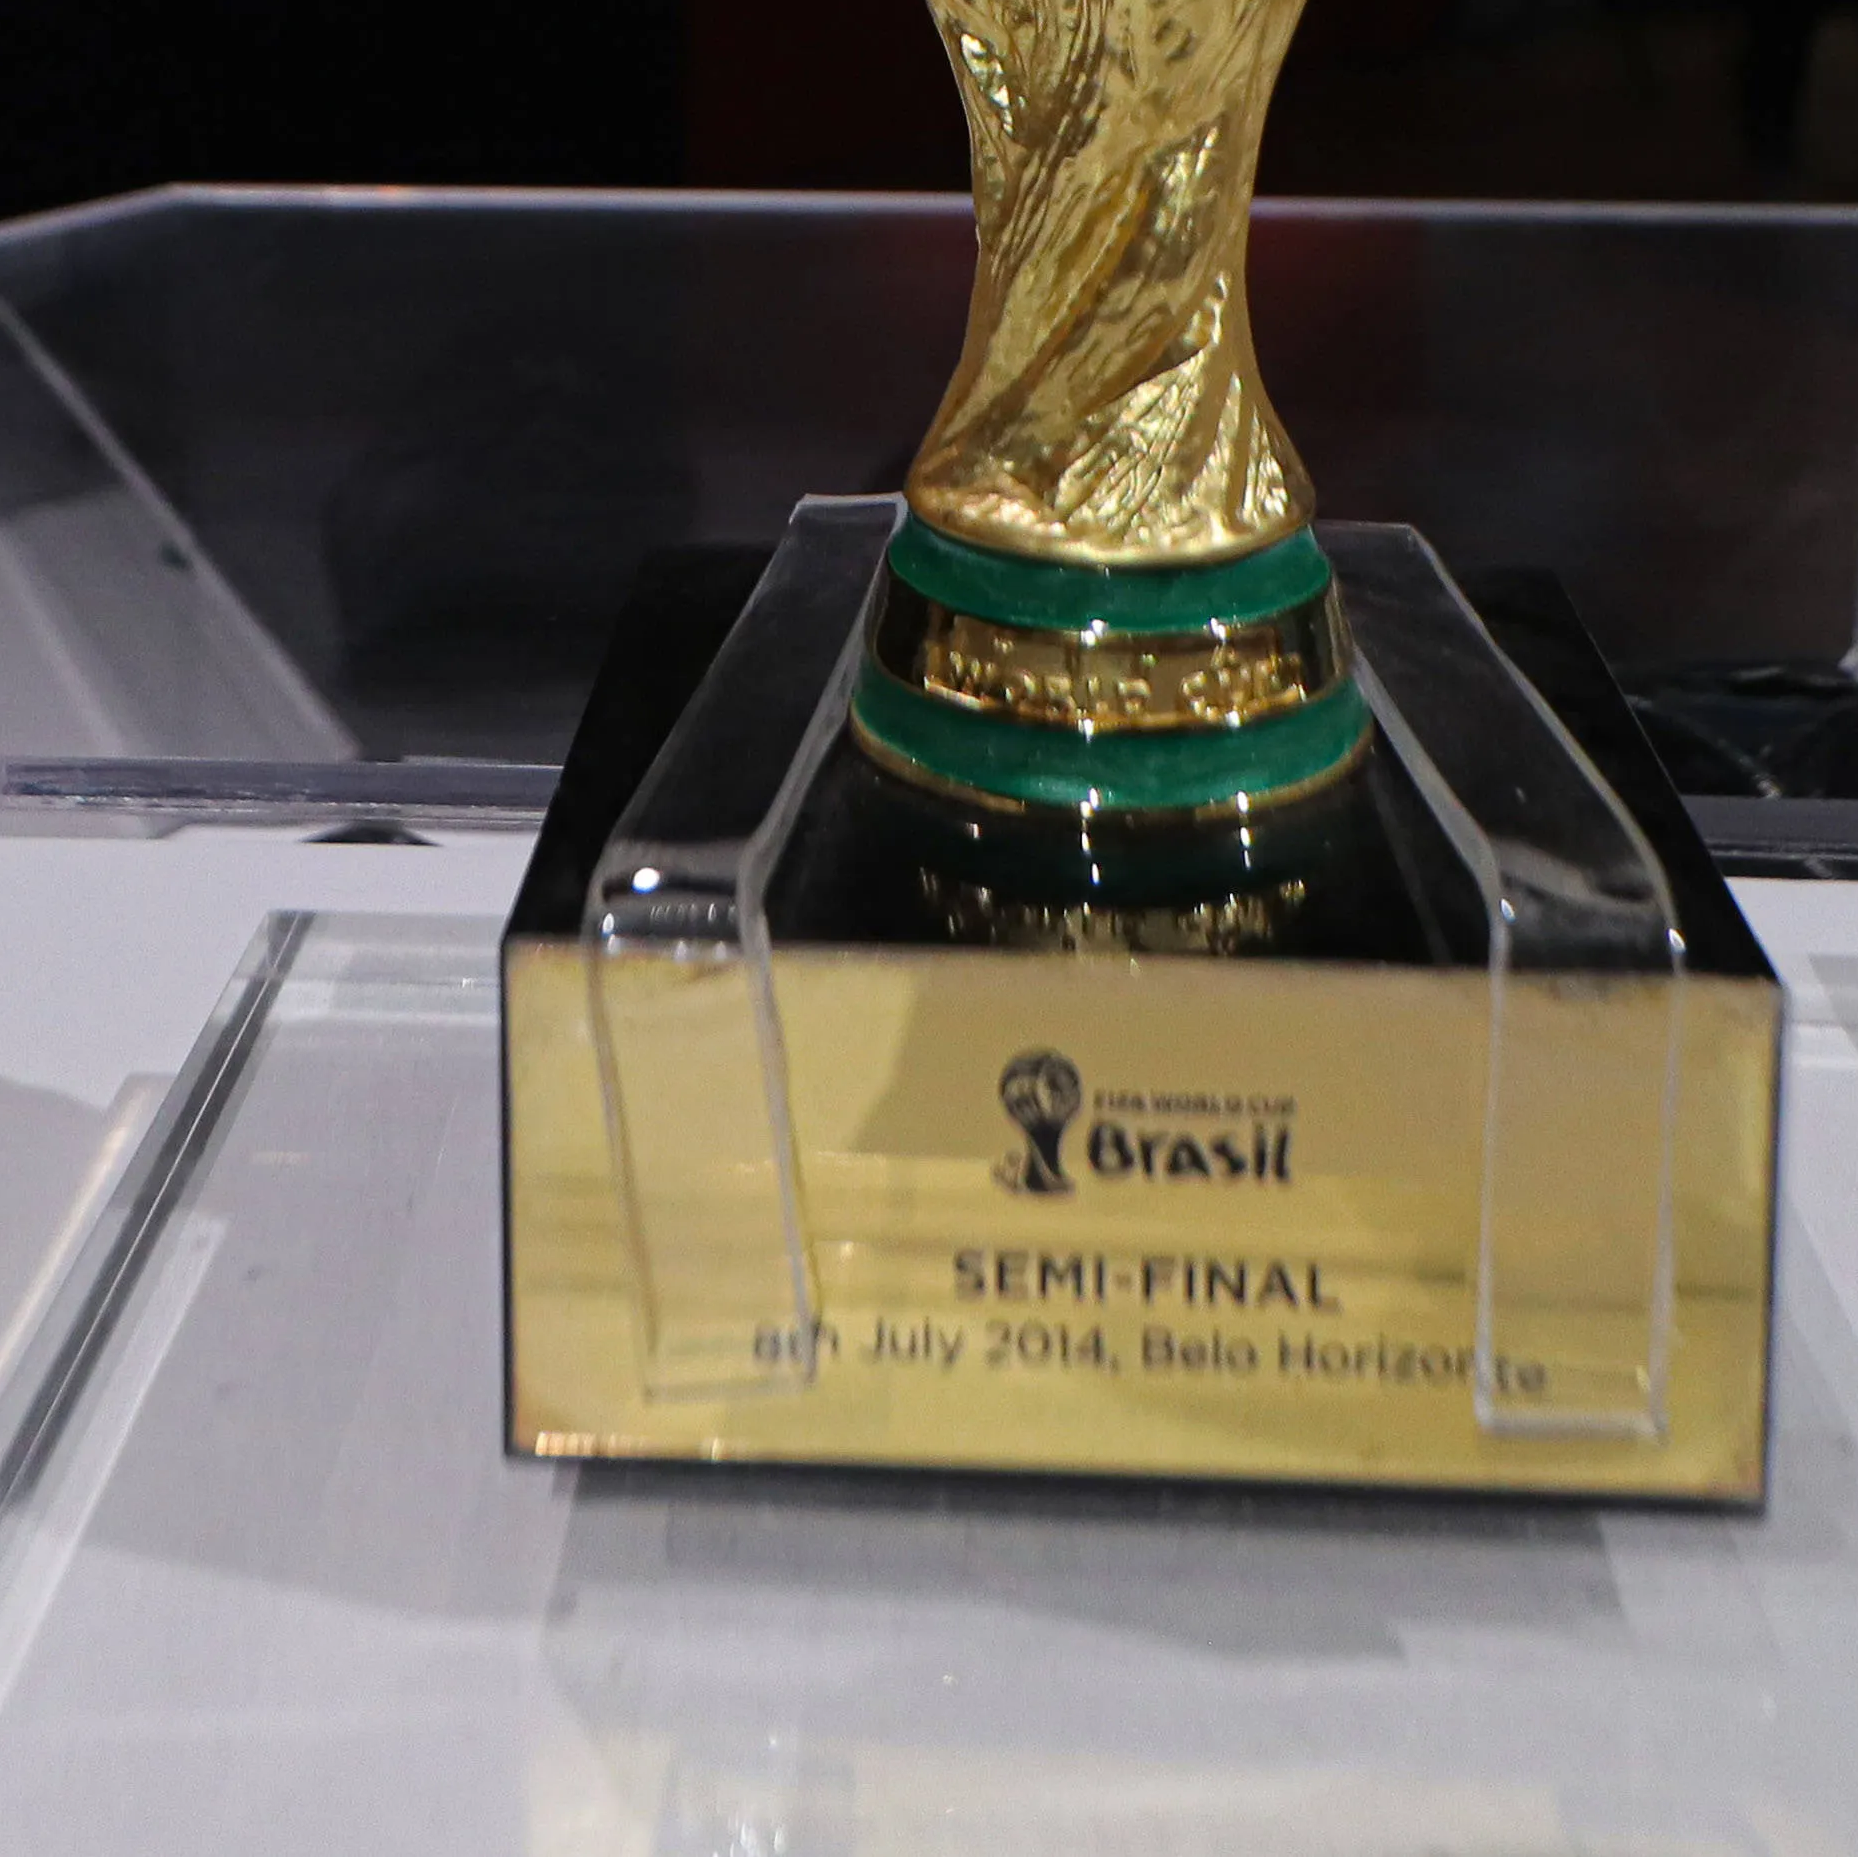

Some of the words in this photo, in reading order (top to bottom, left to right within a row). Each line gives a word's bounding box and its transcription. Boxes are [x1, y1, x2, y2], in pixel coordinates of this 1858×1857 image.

[1088, 1120, 1293, 1182] Brasil
[954, 1249, 1342, 1313] SEMI-FINAL
[860, 1316, 966, 1373] July
[984, 1319, 1119, 1375] 2014,
[1142, 1324, 1259, 1375] Belo
